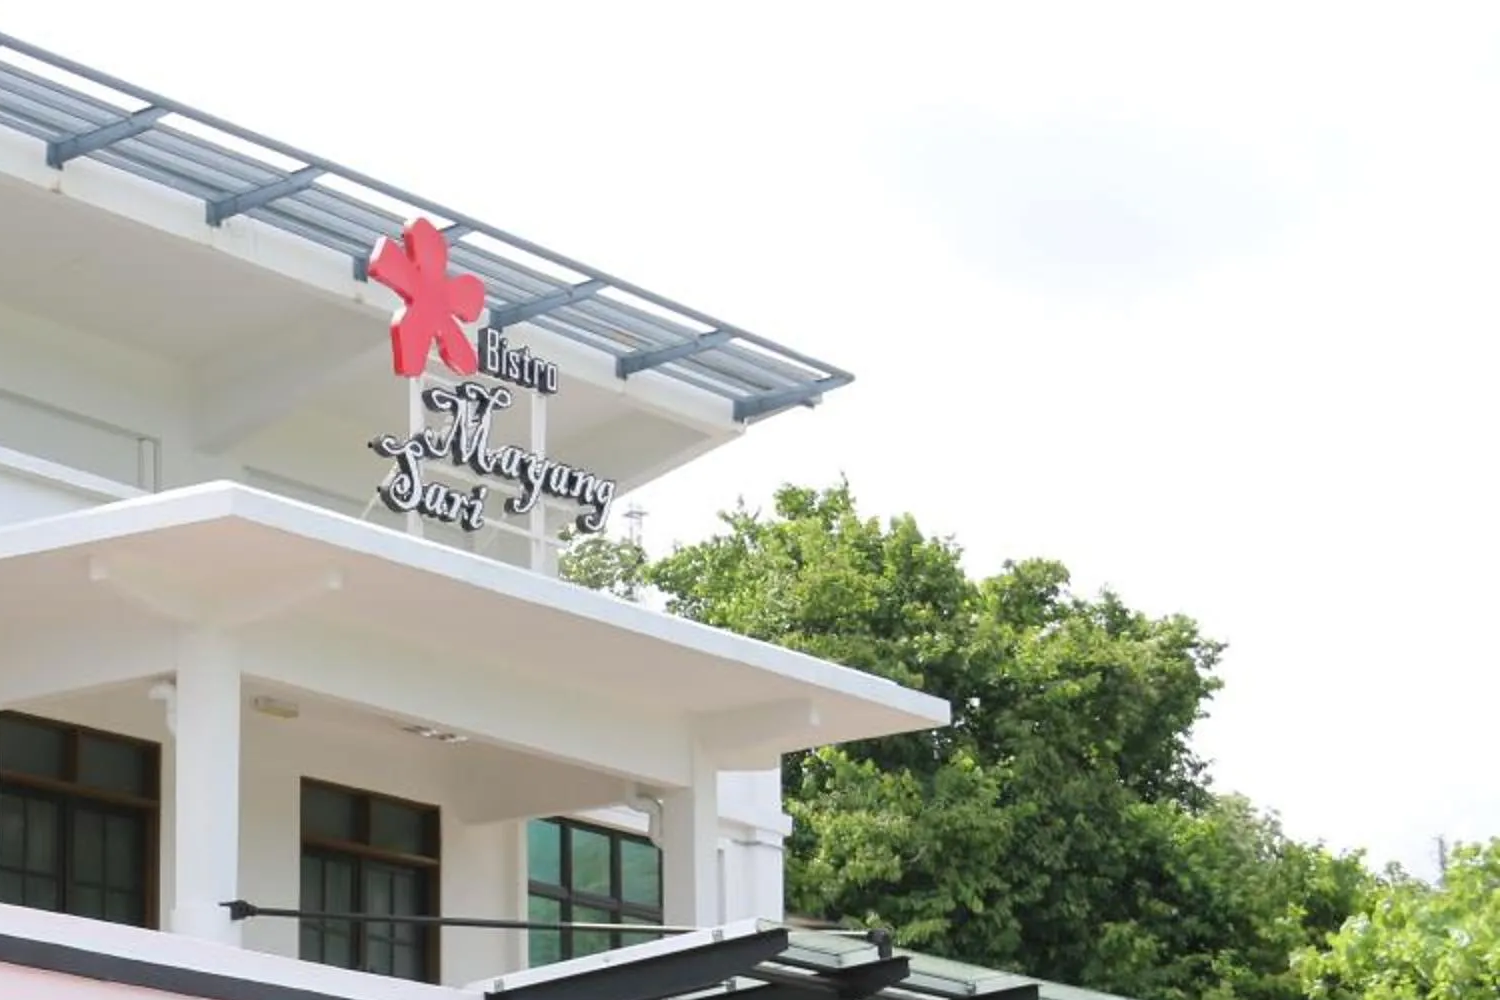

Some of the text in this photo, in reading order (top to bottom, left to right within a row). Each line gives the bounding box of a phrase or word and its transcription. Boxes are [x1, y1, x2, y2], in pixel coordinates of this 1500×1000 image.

[479, 326, 558, 393] Bistro
[369, 434, 488, 531] Sari
[422, 381, 616, 533] Mayang
